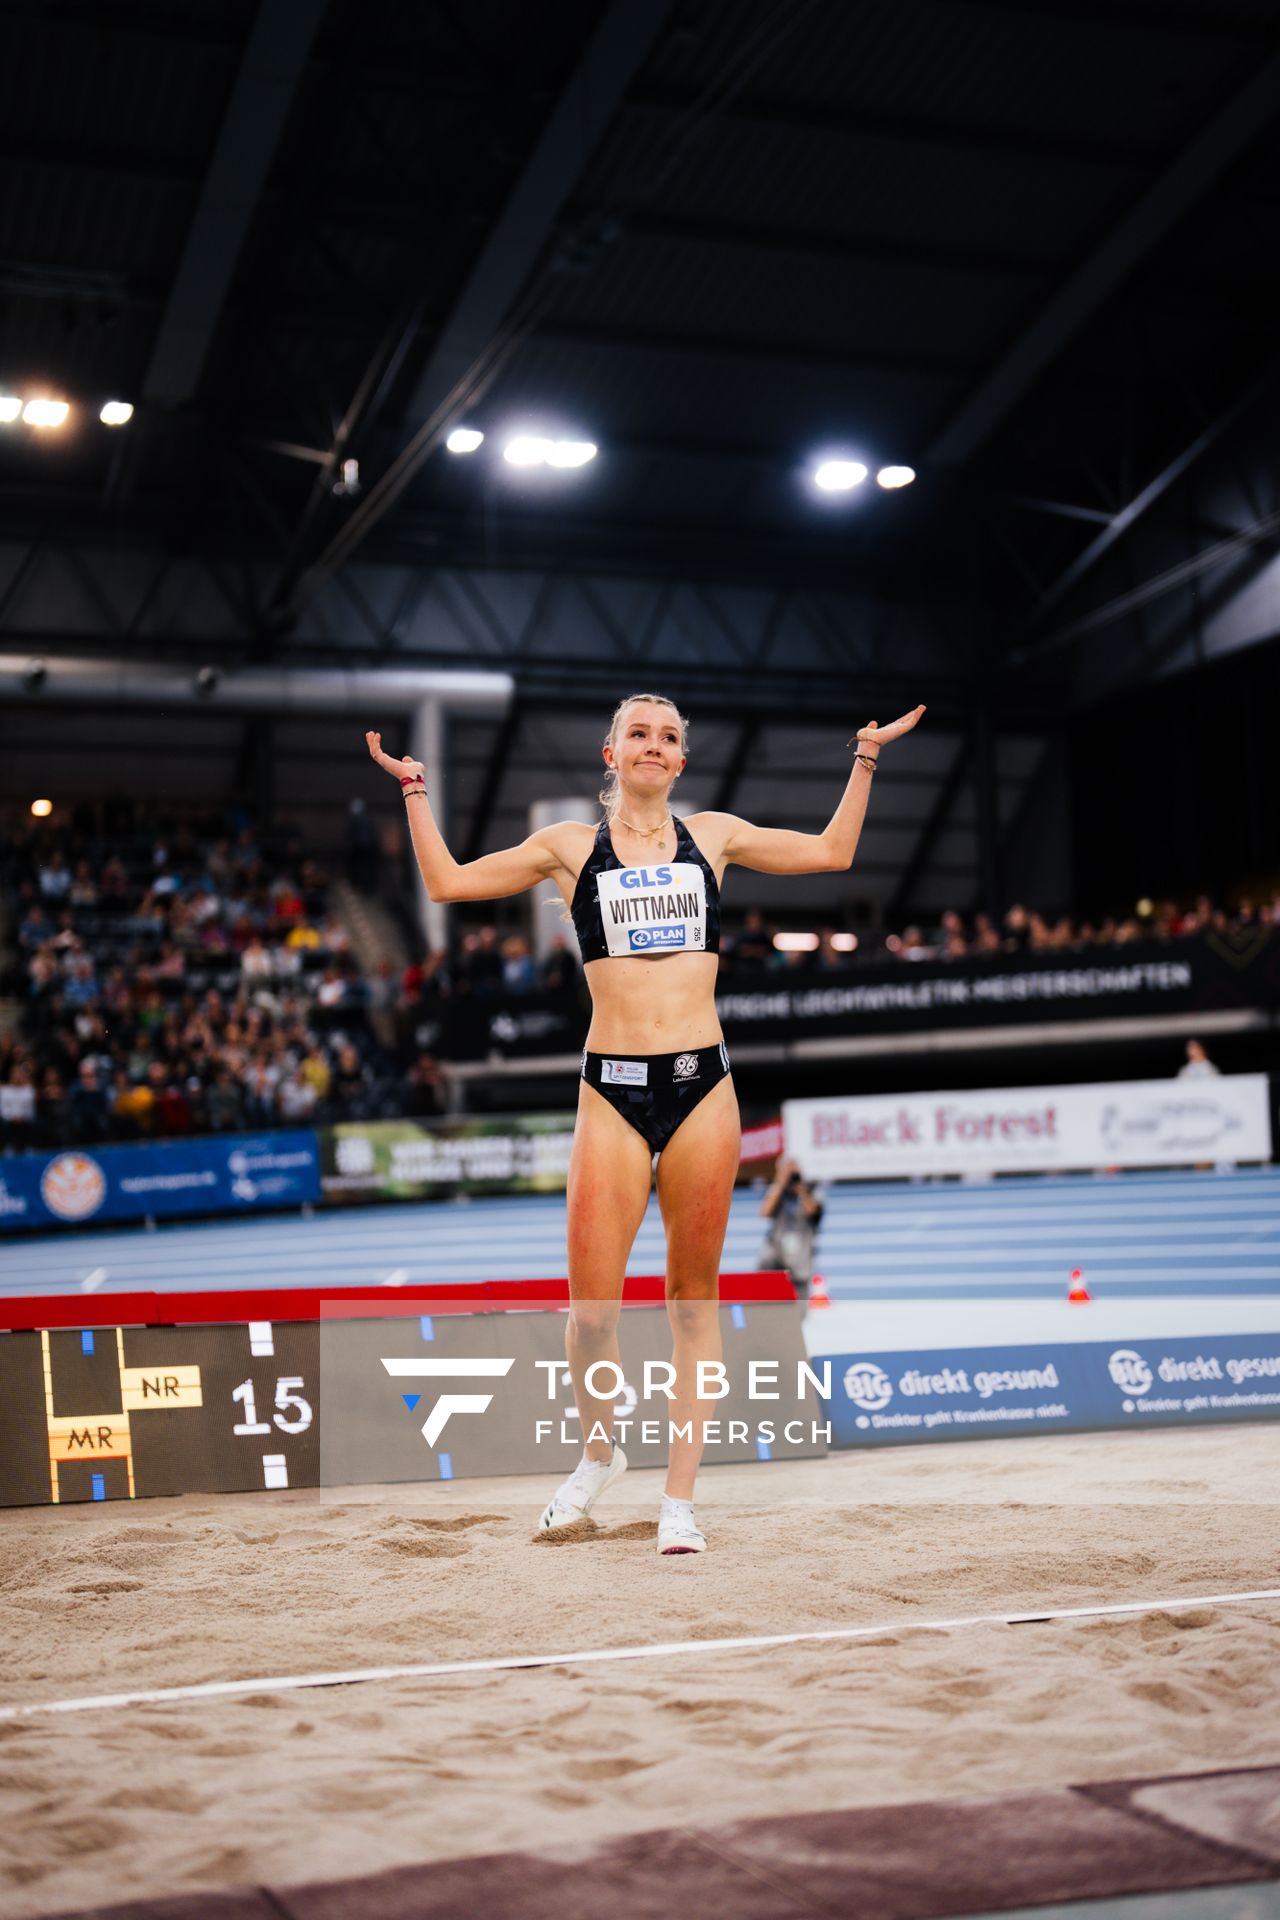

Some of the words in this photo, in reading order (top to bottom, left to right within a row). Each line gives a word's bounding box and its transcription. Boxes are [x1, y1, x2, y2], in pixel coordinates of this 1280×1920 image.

[619, 867, 673, 889] GLS
[609, 893, 699, 924] WITTMANN
[652, 929, 683, 940] PLAN
[693, 927, 702, 942] 255
[675, 1055, 698, 1076] 96
[812, 1110, 921, 1148] Black
[935, 1105, 1056, 1143] Forest
[844, 1373, 893, 1400] BIG
[900, 1368, 971, 1396] direkt
[974, 1363, 1060, 1398] gesund
[1108, 1359, 1153, 1385] BIG
[1158, 1355, 1223, 1382] direkt
[1226, 1357, 1280, 1384] gesu
[142, 1376, 179, 1398] NR
[232, 1377, 312, 1435] 15
[67, 1427, 113, 1450] MR
